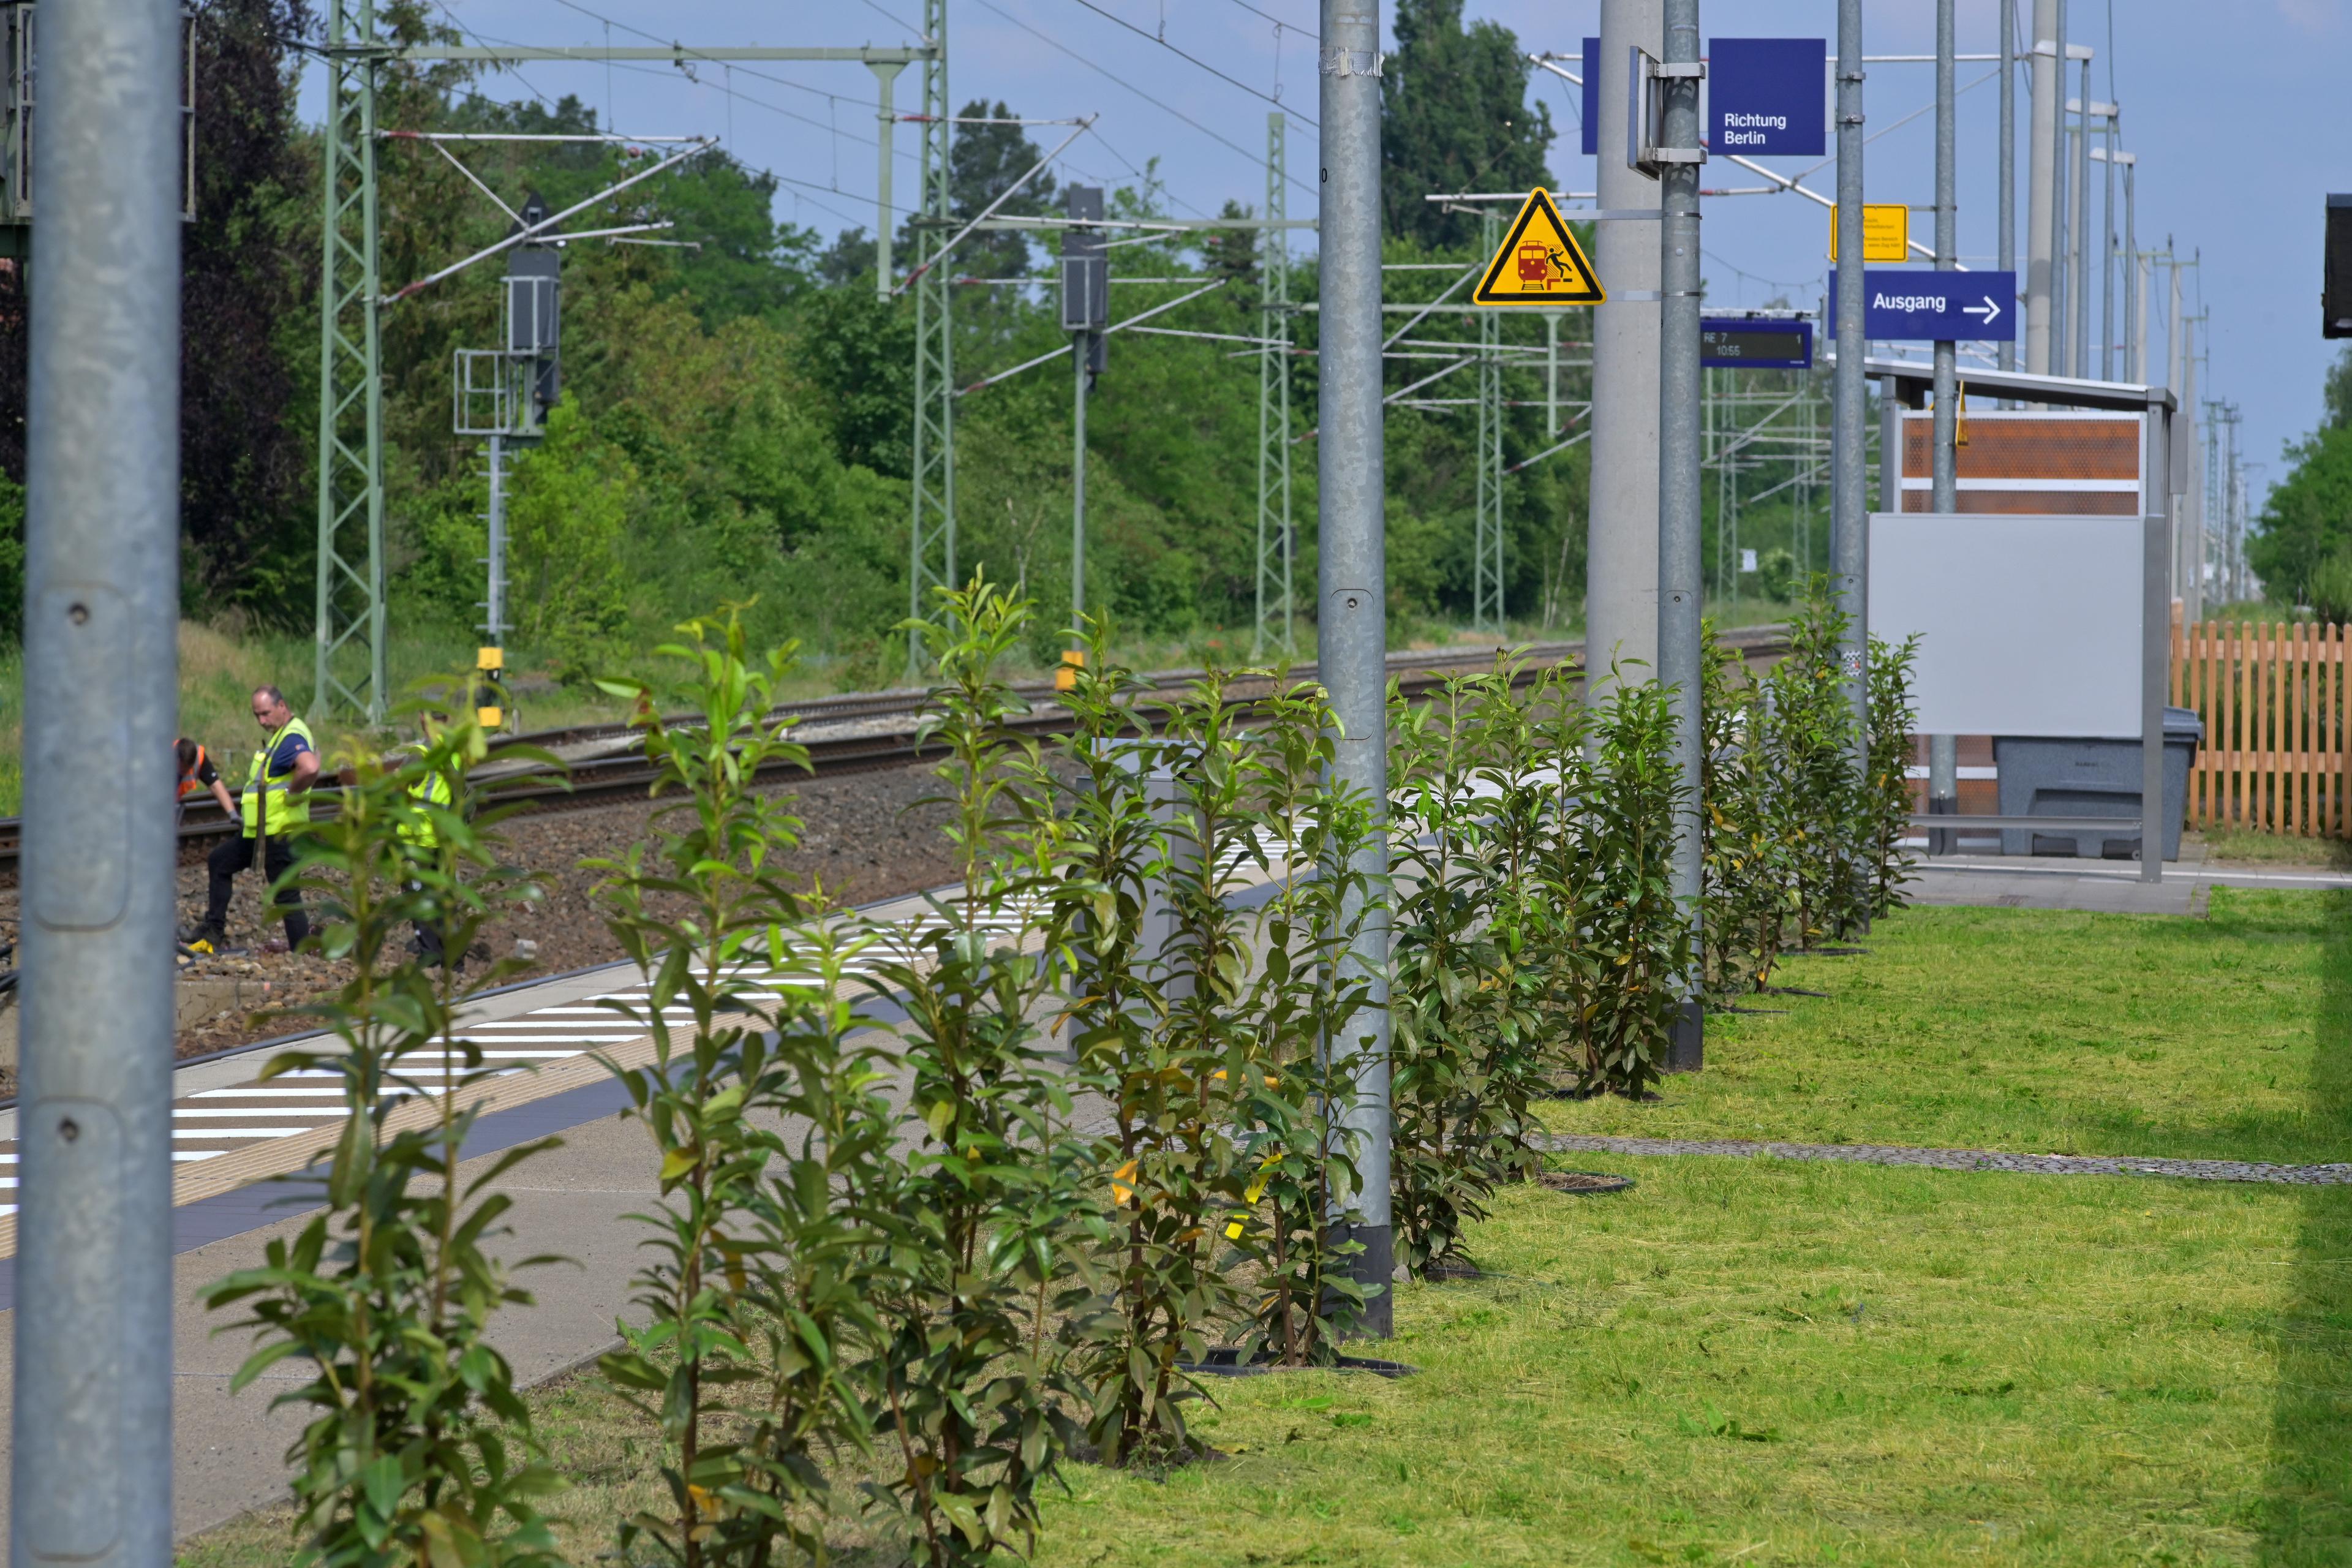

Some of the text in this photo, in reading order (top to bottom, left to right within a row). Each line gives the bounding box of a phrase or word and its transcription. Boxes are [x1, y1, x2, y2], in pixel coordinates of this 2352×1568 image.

[1725, 113, 1787, 130] Richtung
[1725, 130, 1766, 145] Berlin
[1873, 292, 1946, 313] Ausgang
[1704, 332, 1728, 343] RE 7
[1796, 334, 1801, 344] 1
